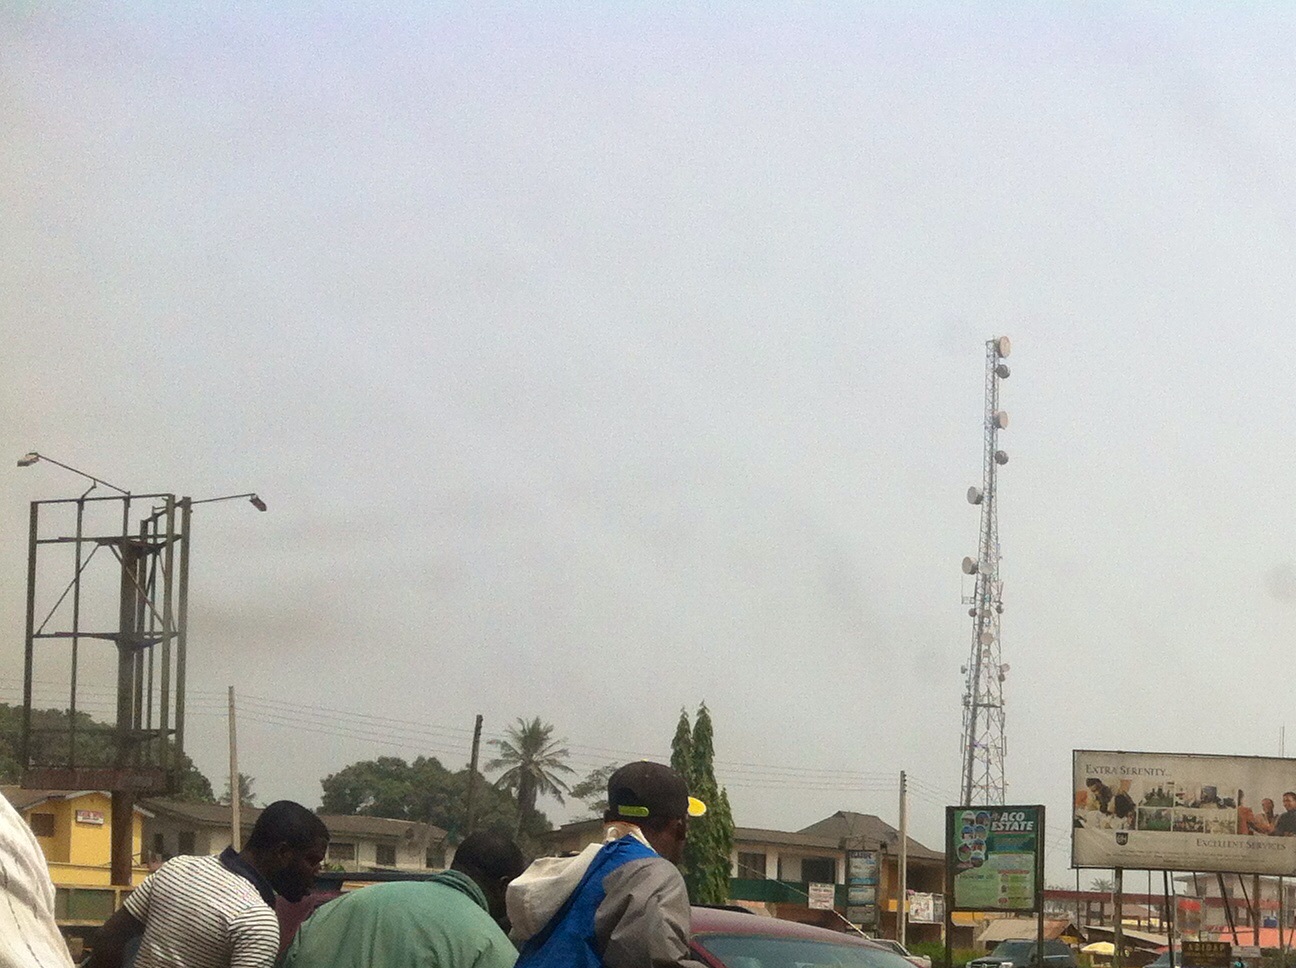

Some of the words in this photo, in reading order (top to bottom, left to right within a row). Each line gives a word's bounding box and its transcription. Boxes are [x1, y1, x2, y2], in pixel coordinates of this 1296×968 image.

[1085, 764, 1116, 775] EXTRA
[1000, 811, 1025, 822] ACO
[991, 820, 1034, 831] ESTATE
[1196, 838, 1243, 848] EXCELLENT
[1246, 840, 1286, 851] SERVICES
